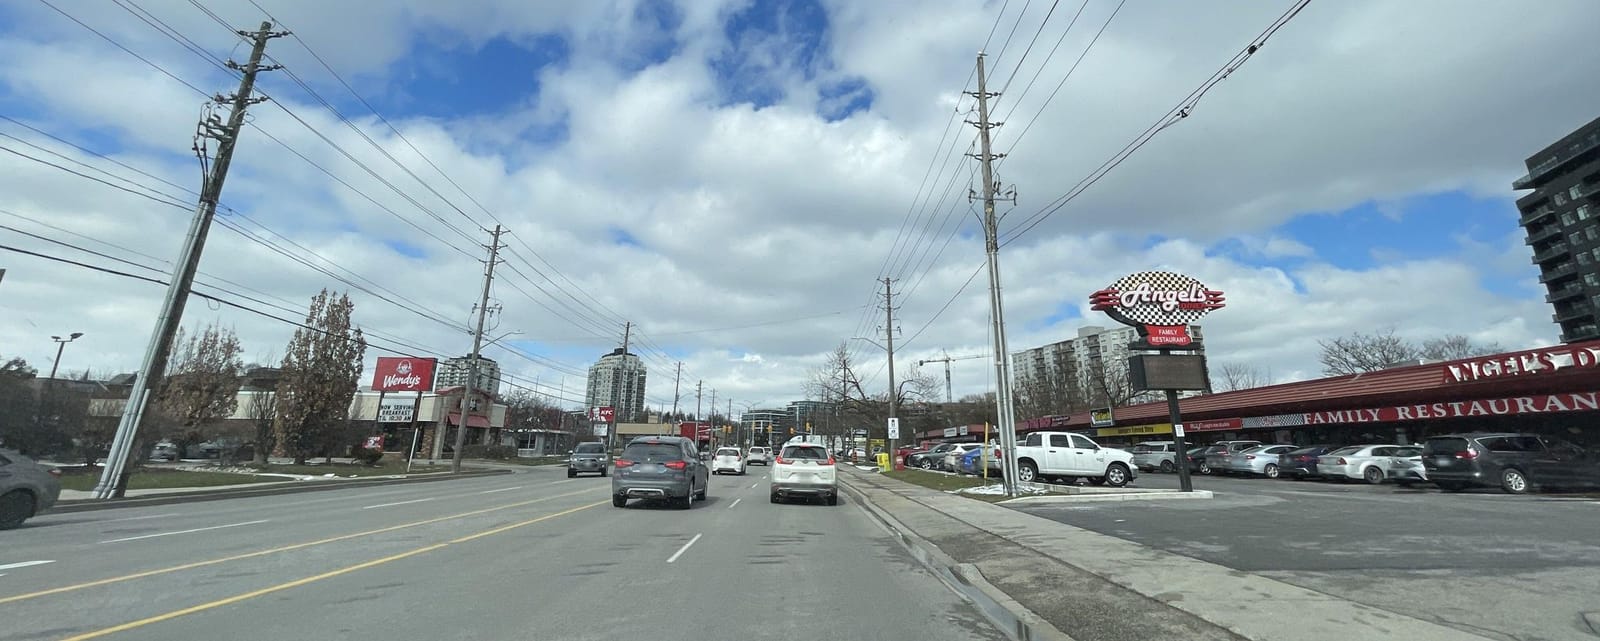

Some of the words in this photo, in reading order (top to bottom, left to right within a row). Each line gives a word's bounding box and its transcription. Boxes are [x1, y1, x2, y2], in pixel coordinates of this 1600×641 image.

[1151, 336, 1187, 344] RESTAURANT
[384, 373, 421, 388] Wendy's
[1303, 409, 1381, 425] FAMILY
